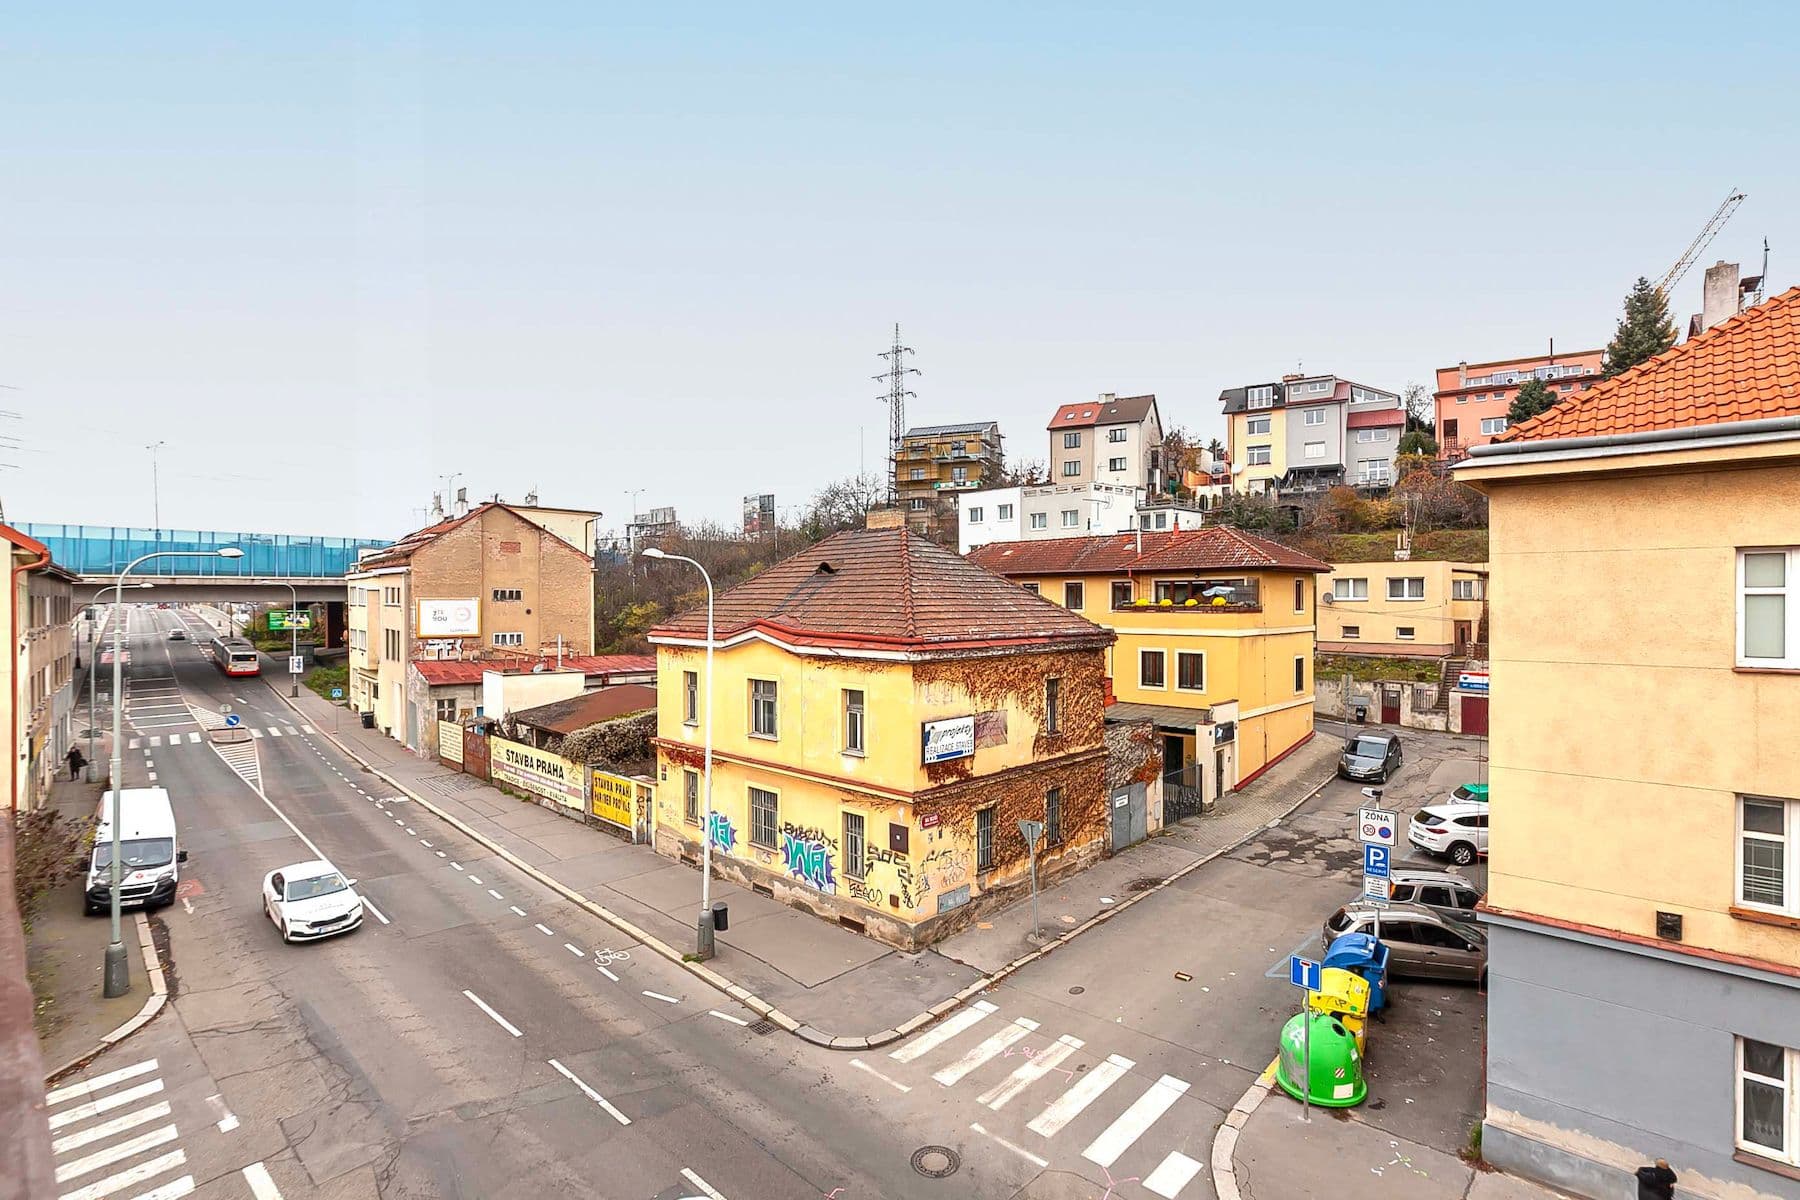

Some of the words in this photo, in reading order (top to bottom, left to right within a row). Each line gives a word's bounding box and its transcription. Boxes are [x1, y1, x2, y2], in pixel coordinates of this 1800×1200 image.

[505, 748, 535, 770] STAVBA
[535, 758, 565, 780] PRAHA
[1369, 847, 1385, 867] P
